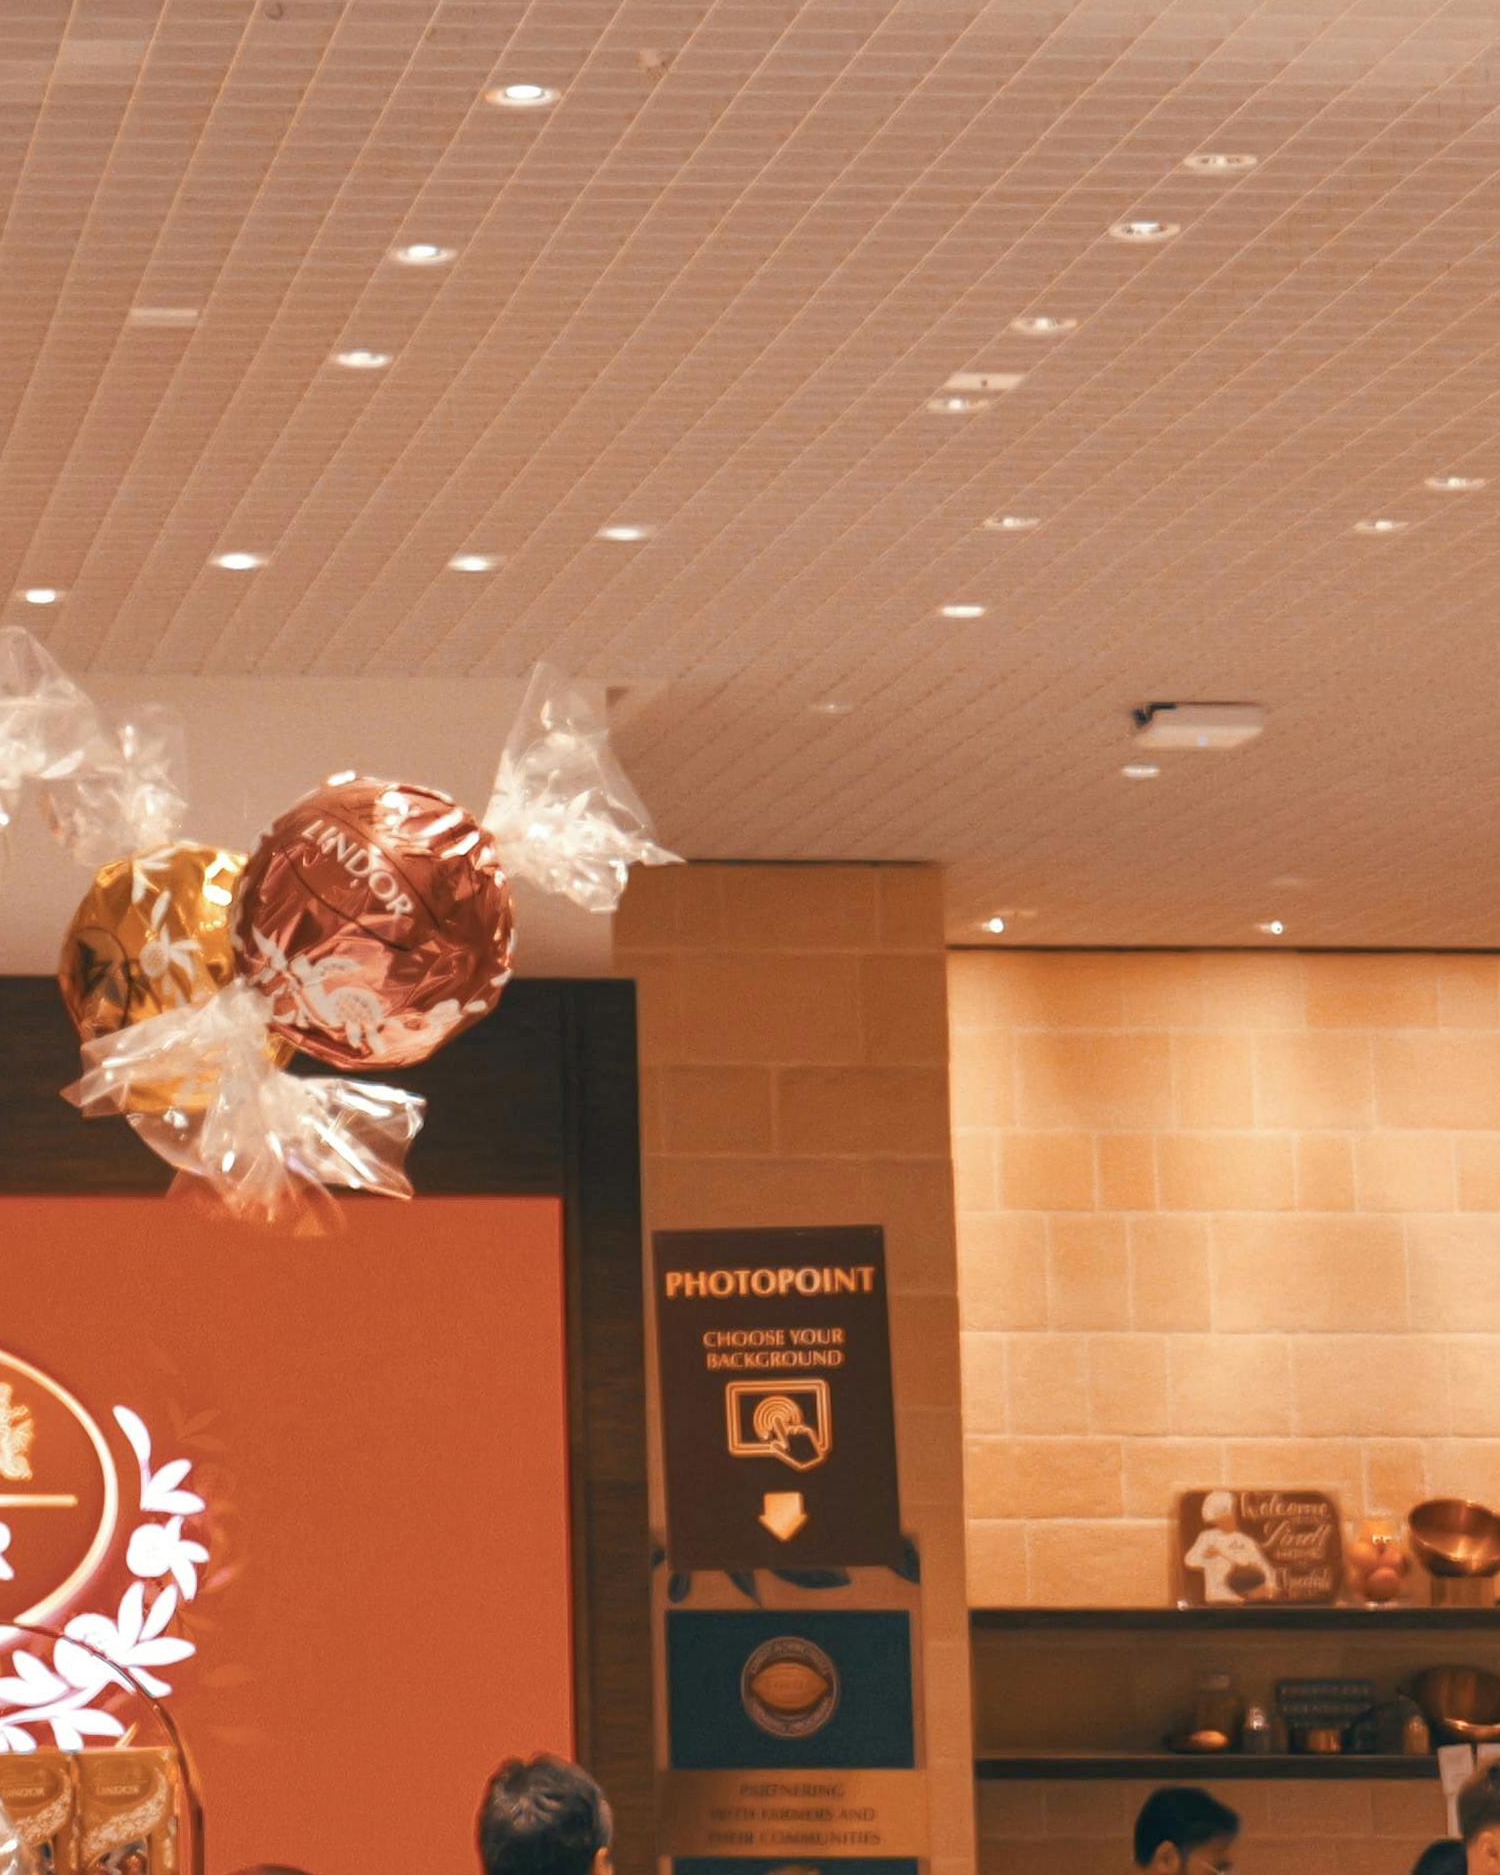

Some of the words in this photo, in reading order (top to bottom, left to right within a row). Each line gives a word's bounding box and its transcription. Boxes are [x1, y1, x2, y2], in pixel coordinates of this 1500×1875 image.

[301, 819, 414, 920] LINDOR
[665, 1266, 875, 1298] PHOTOPOINT
[703, 1330, 785, 1348] CHOOSE
[790, 1328, 844, 1345] YOUR
[706, 1349, 843, 1370] BACKGROUND
